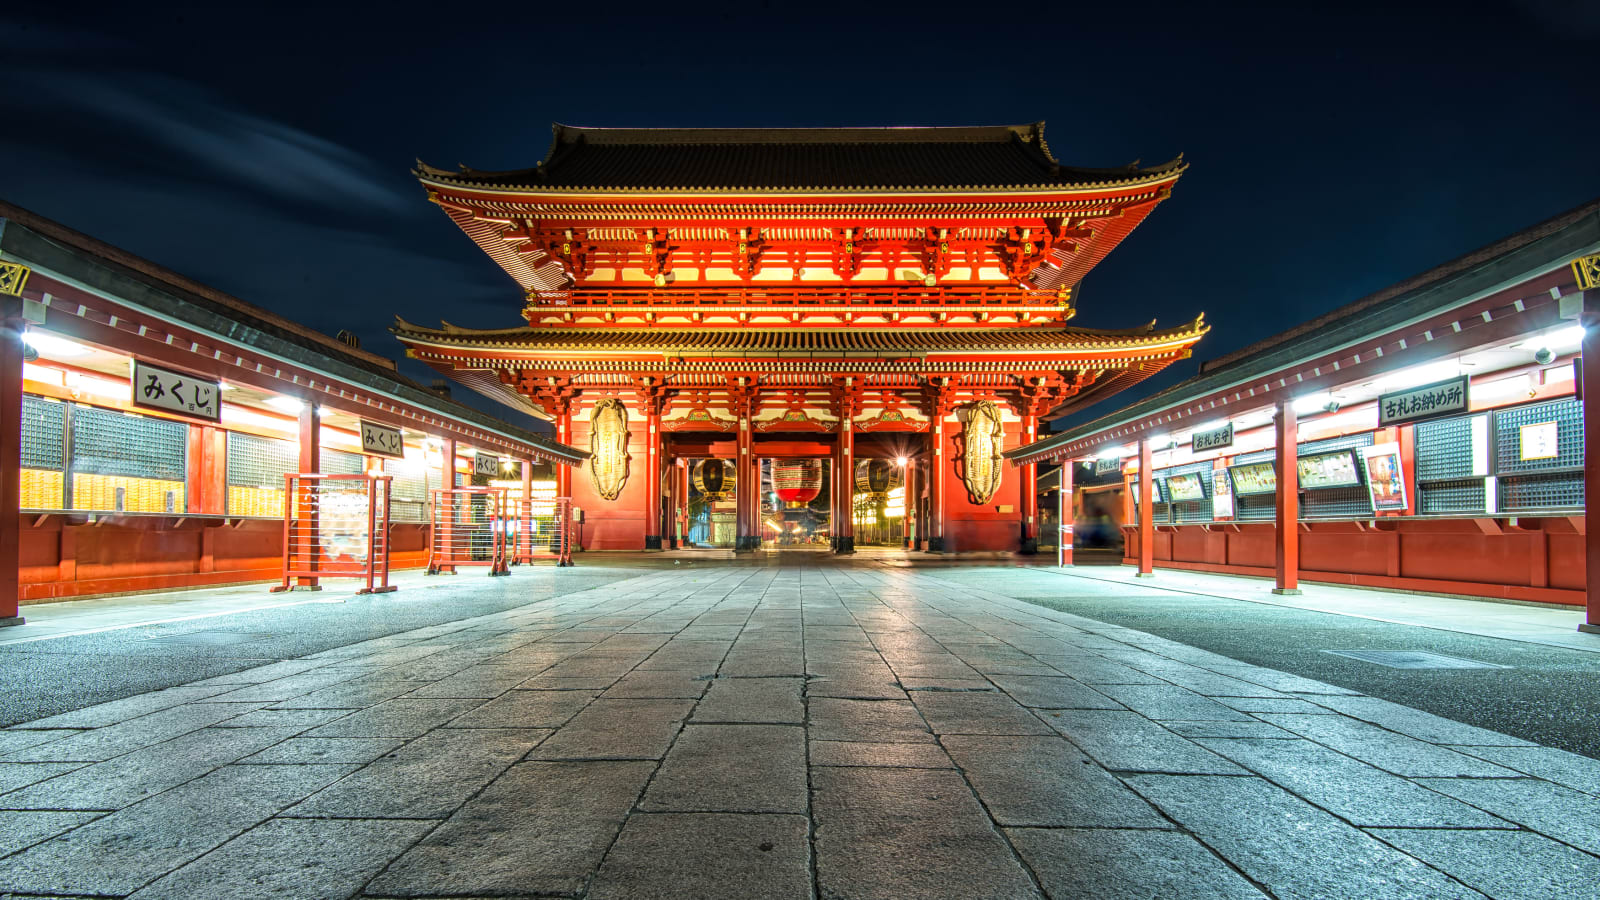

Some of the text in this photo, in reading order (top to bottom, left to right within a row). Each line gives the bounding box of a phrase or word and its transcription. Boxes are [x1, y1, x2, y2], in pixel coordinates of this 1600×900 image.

[144, 375, 209, 408] みくじ
[1385, 386, 1463, 418] 古札お納め所
[366, 429, 399, 448] みくじ
[1196, 429, 1229, 448] お札お守
